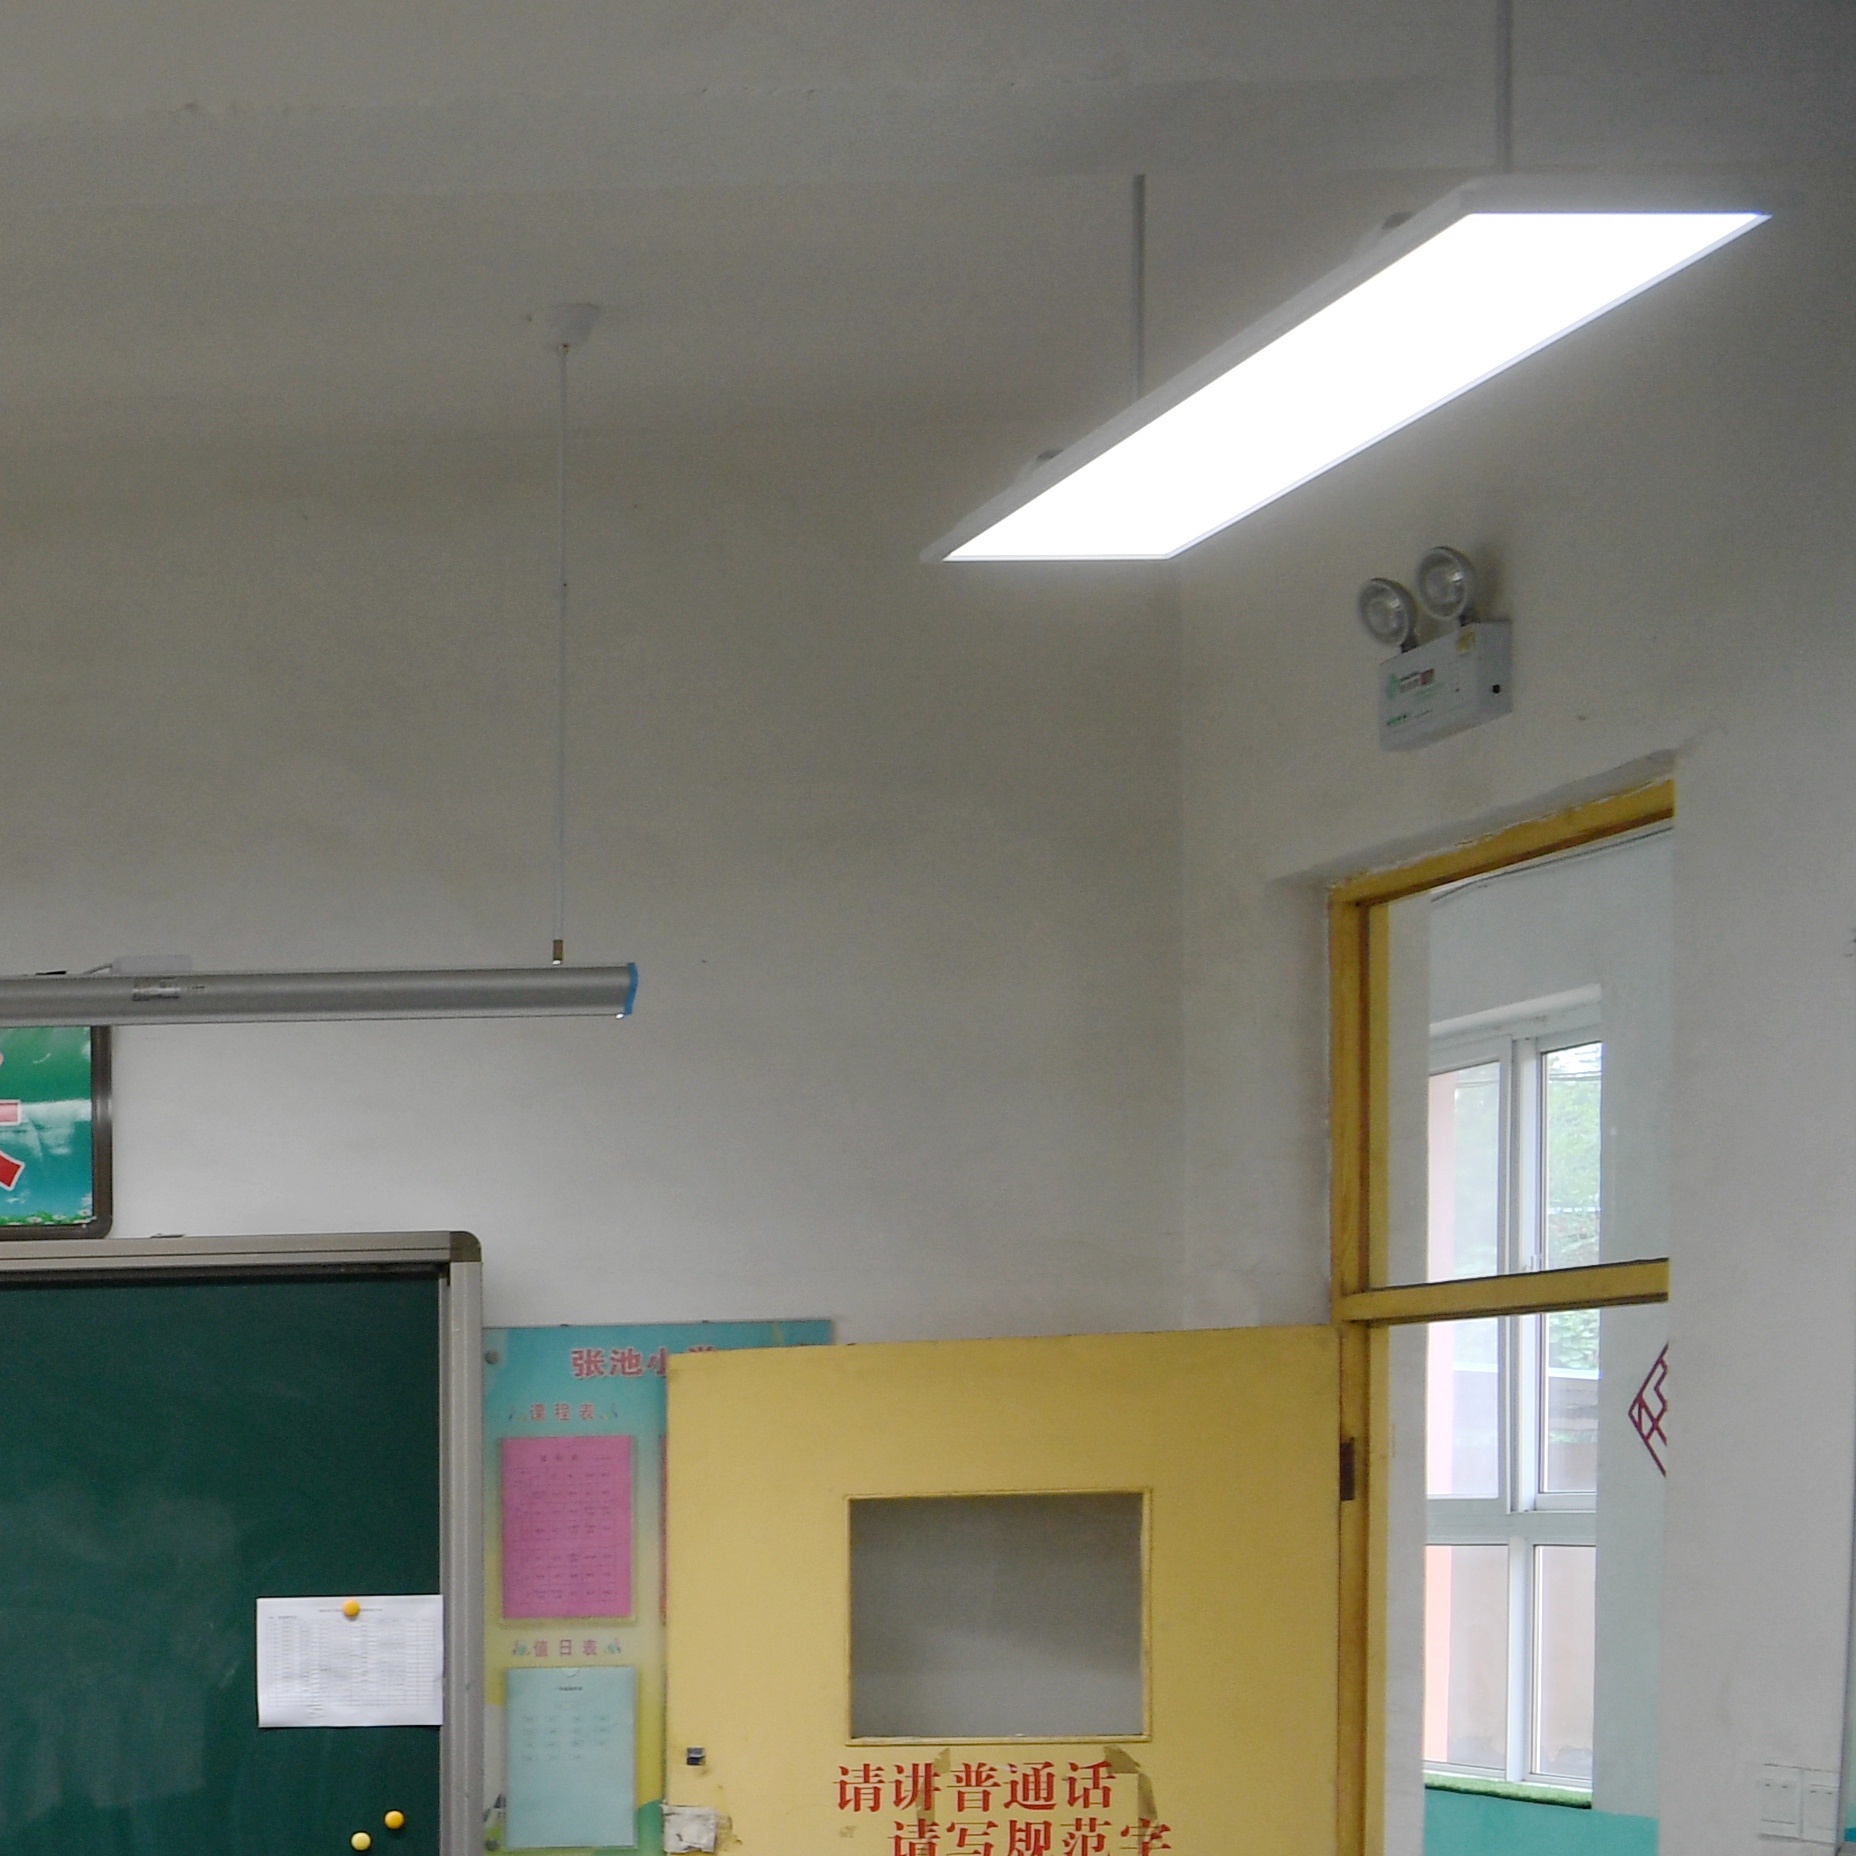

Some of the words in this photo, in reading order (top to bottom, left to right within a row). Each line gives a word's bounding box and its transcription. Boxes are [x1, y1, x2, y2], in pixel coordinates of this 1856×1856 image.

[530, 1403, 595, 1422] 课程表
[534, 1639, 597, 1657] 值日表
[833, 1760, 1117, 1814] 请讲普通话
